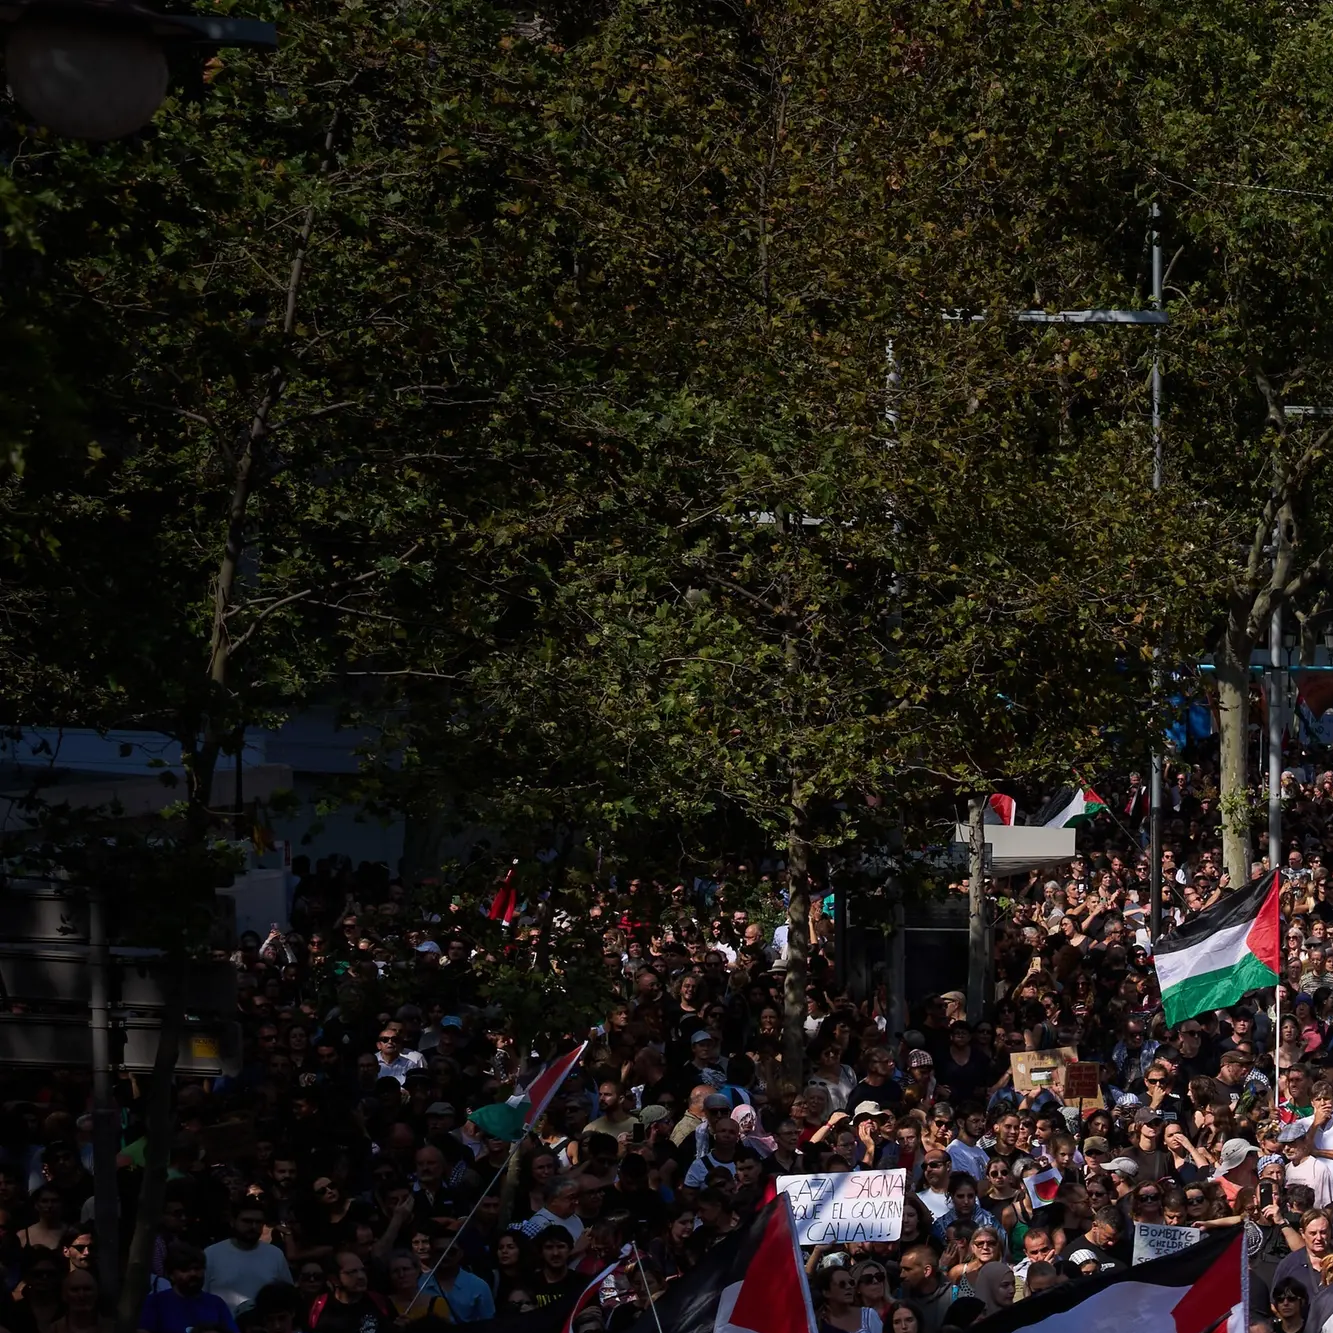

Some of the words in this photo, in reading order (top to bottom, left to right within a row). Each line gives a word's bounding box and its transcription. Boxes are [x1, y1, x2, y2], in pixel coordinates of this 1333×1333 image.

[844, 1174, 904, 1199] SAGNA
[832, 1202, 847, 1220] EL
[851, 1200, 902, 1221] GOVERN
[807, 1221, 892, 1243] CALLA!!!
[1140, 1225, 1195, 1242] BOMBING
